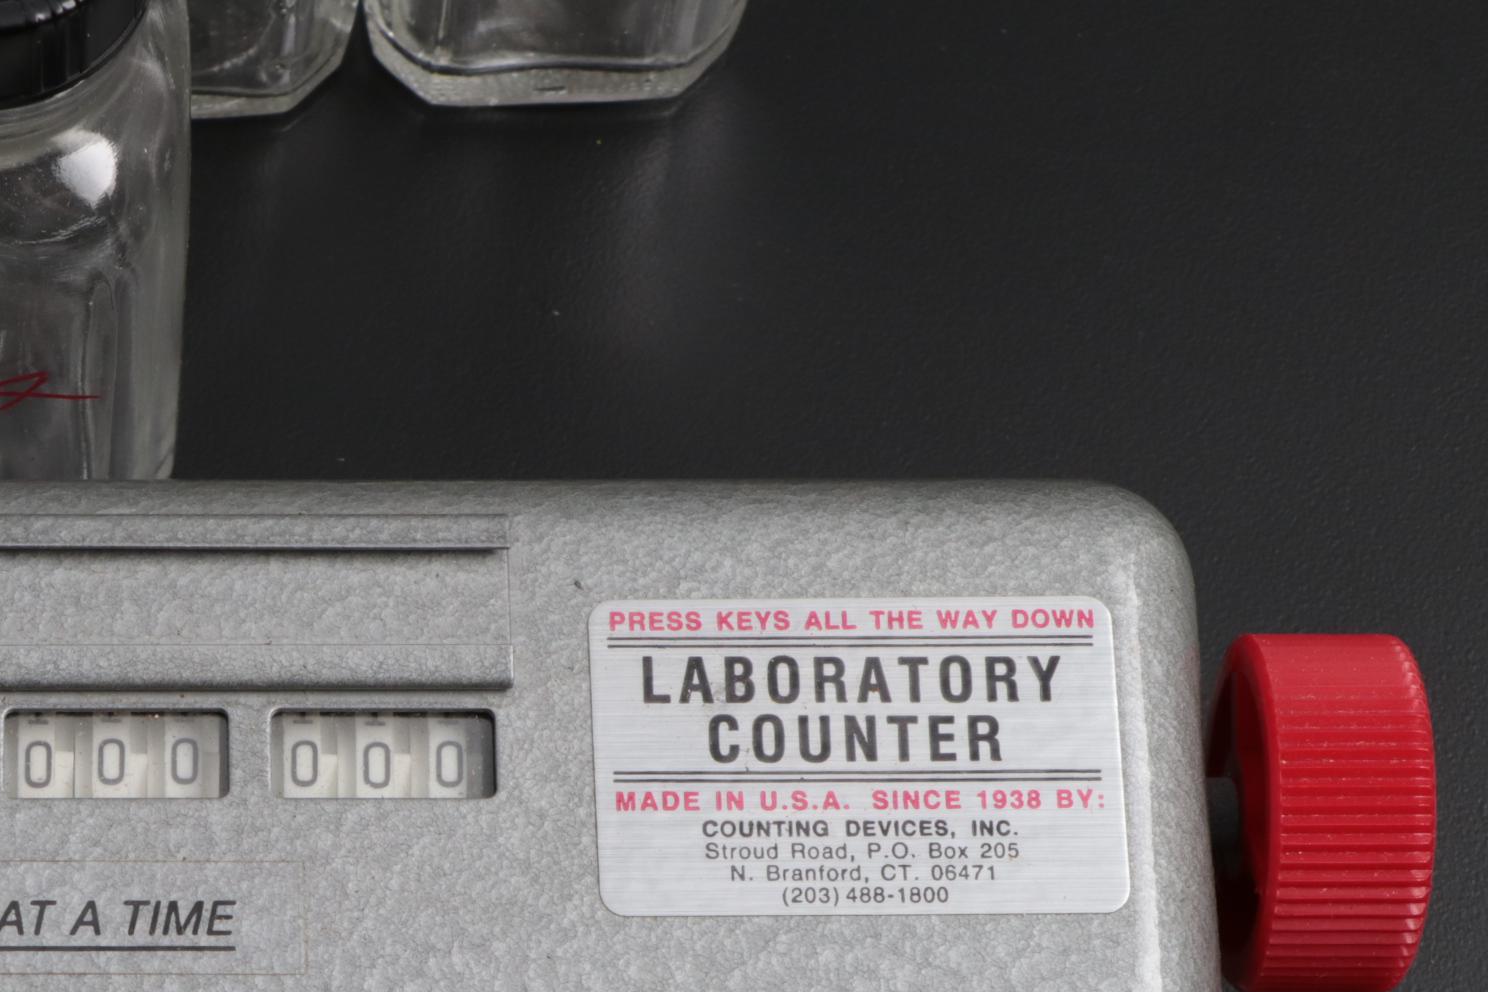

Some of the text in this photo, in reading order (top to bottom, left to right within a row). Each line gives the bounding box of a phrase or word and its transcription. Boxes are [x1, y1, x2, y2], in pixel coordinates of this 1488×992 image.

[609, 608, 1095, 632] PRESS KEYS ALL THE WAY DOWN
[642, 655, 1061, 704] LABORATORY
[708, 714, 1004, 763] COUNTER
[616, 789, 1105, 812] MADE IN U.S.A. SINCE 1938 BY:
[702, 820, 1019, 840] COUNTING DEVICES, INC.
[705, 842, 1020, 862] Stroud Road, P.O. Box 205
[730, 865, 996, 884] N. Branford, CT. 06471
[782, 886, 949, 907] (203) 488-1800
[69, 900, 102, 936] A
[123, 900, 237, 936] TIME
